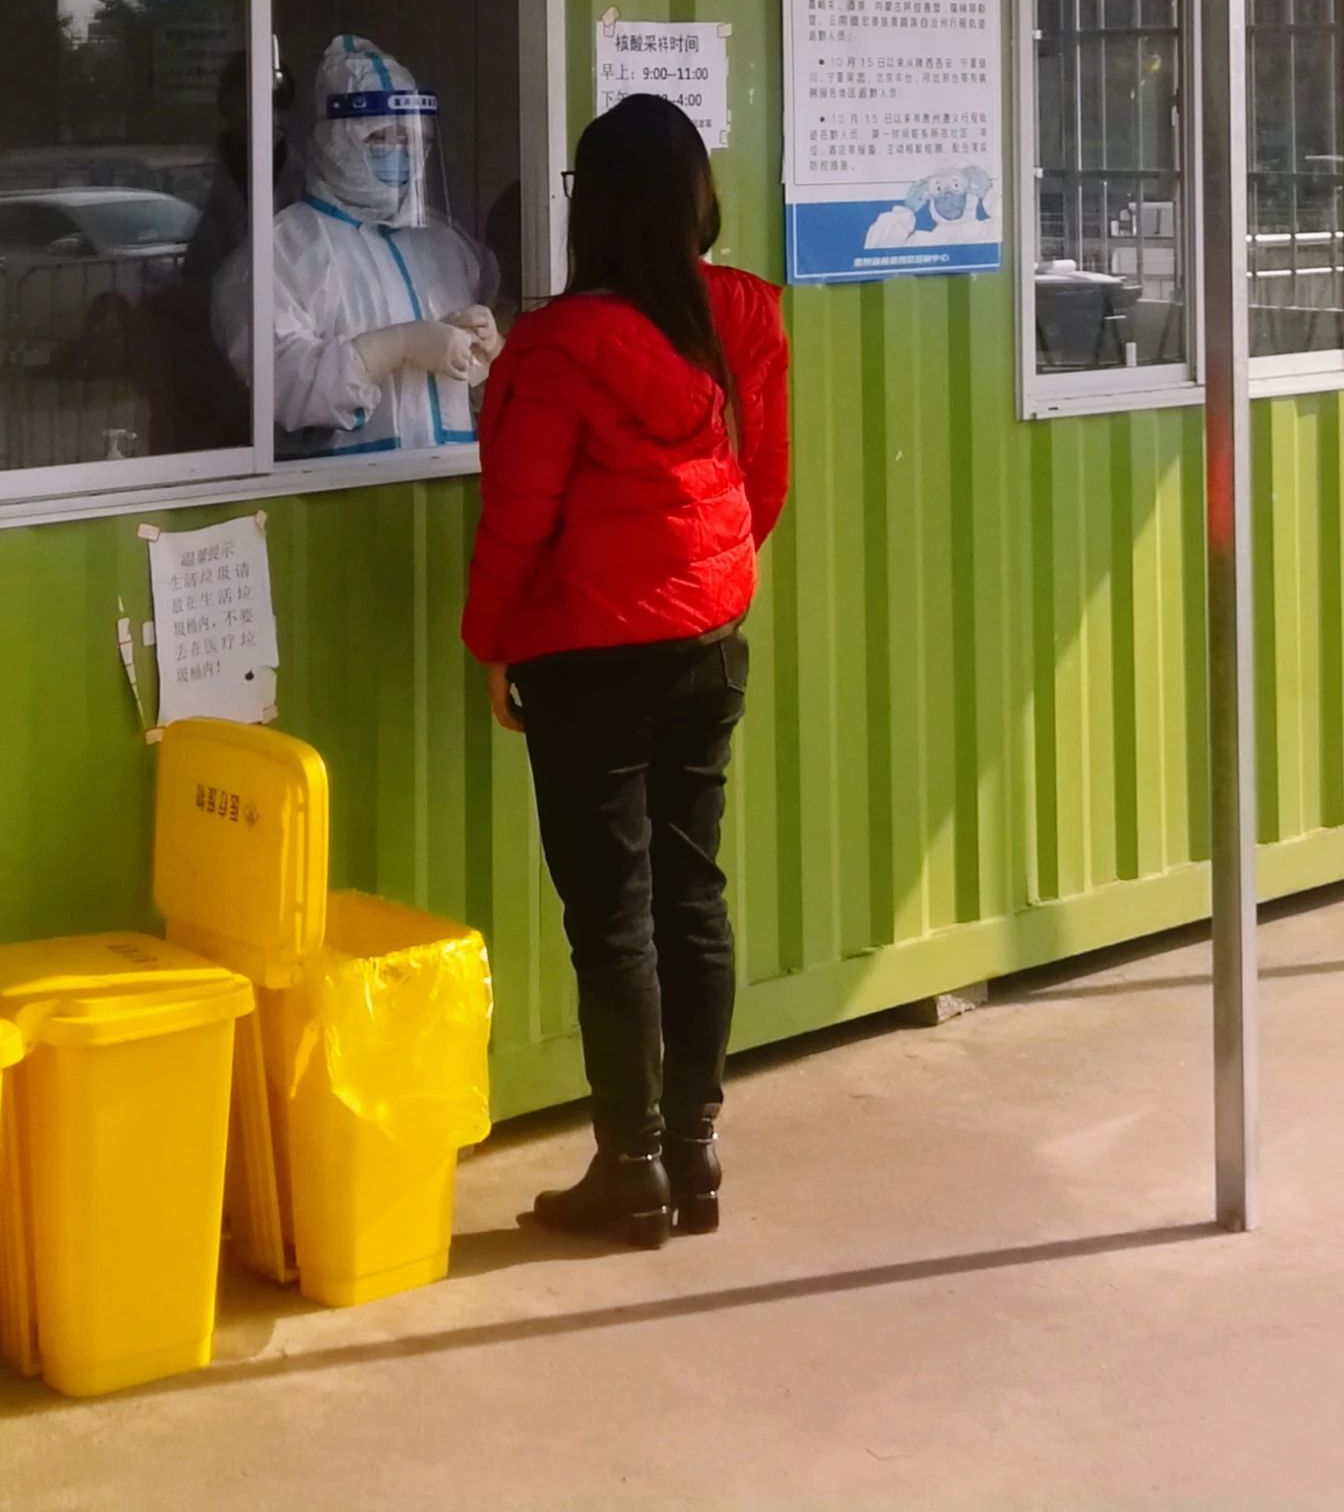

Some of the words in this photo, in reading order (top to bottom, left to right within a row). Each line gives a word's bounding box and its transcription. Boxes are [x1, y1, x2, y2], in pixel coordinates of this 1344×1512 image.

[615, 34, 700, 53] 核酸采样时间
